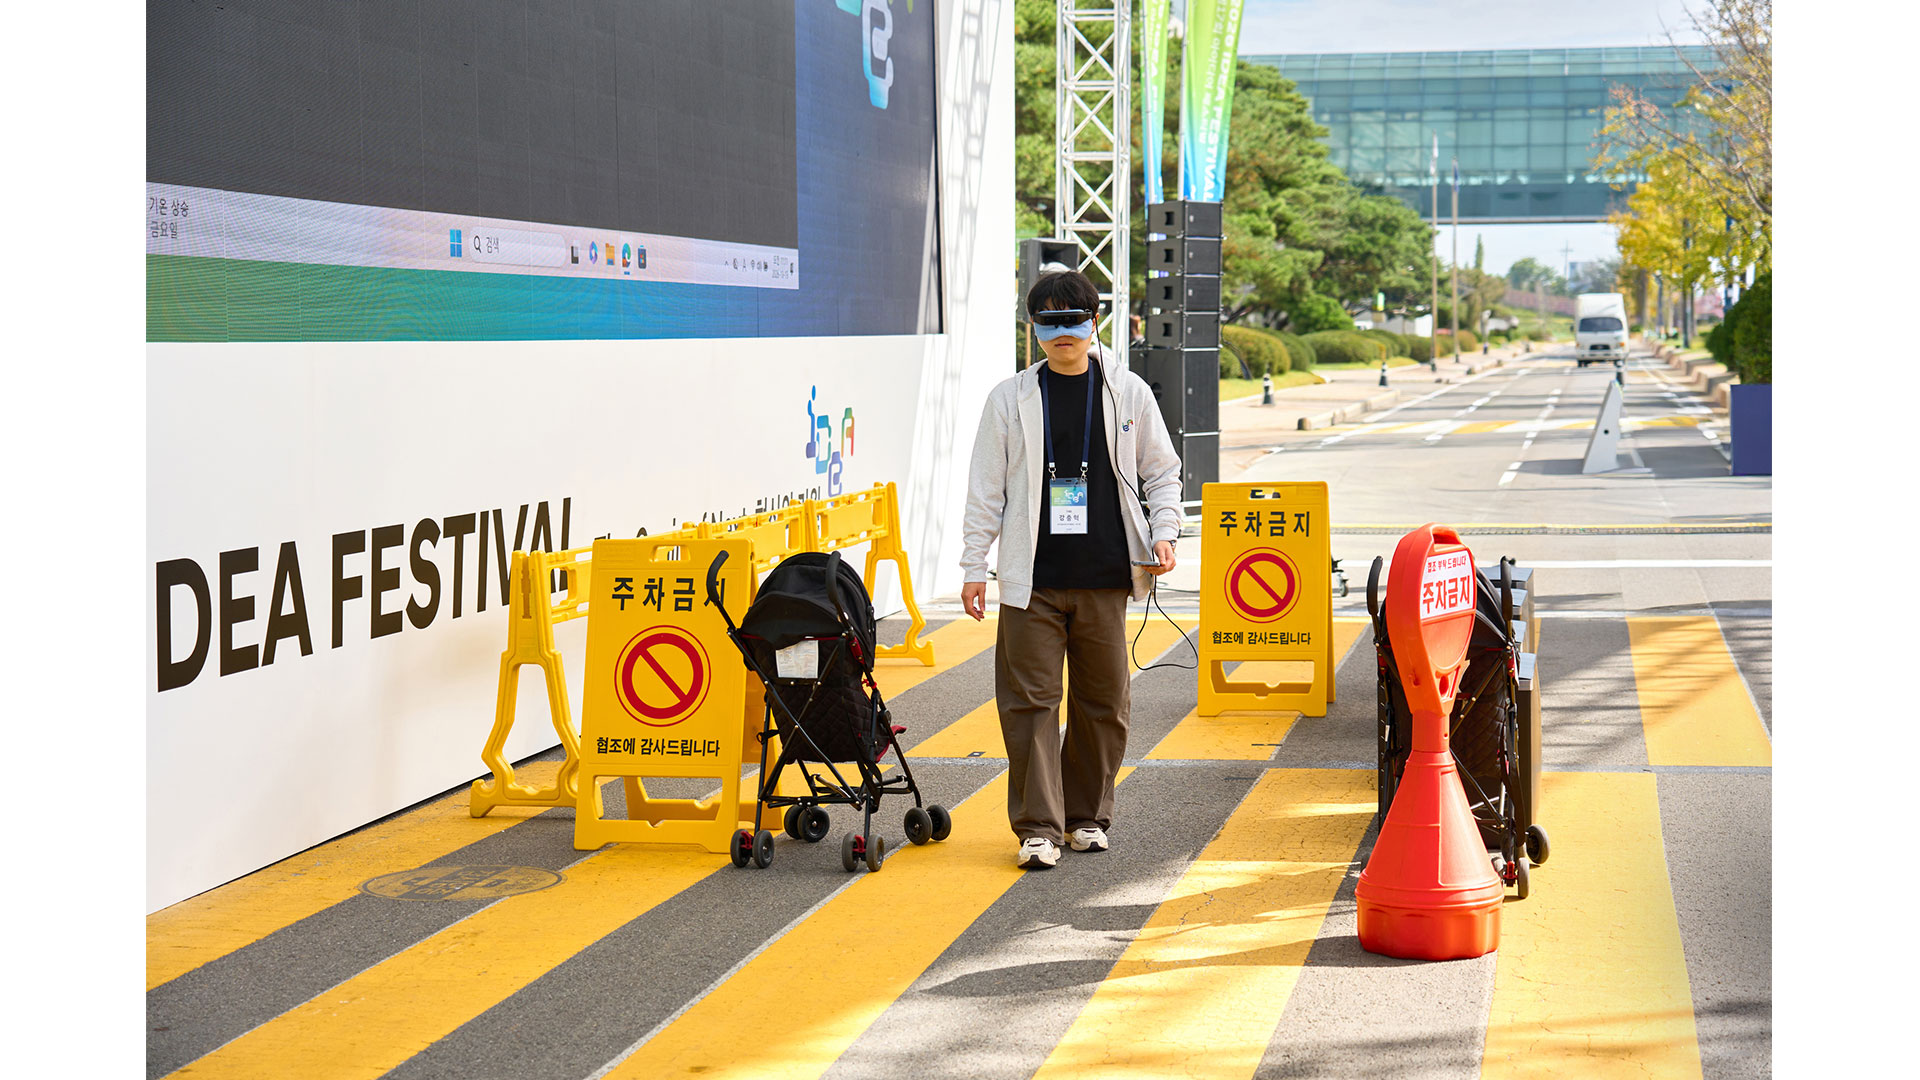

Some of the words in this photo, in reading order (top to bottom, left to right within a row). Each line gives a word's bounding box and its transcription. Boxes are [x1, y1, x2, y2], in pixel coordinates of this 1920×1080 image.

[1215, 51, 1231, 102] IDEA
[1202, 106, 1222, 201] FESTIVAL
[150, 196, 168, 216] 기온
[171, 198, 190, 218] 상승
[150, 220, 178, 239] 금요일
[486, 236, 500, 254] 검색
[1219, 511, 1310, 537] 주차금지
[1422, 575, 1470, 614] 주차금지
[156, 541, 314, 693] DEA
[1212, 631, 1243, 645] 협조에
[1247, 631, 1311, 645] 감사드립니다
[596, 736, 636, 755] 협조에
[640, 738, 720, 757] 감사드립니다
